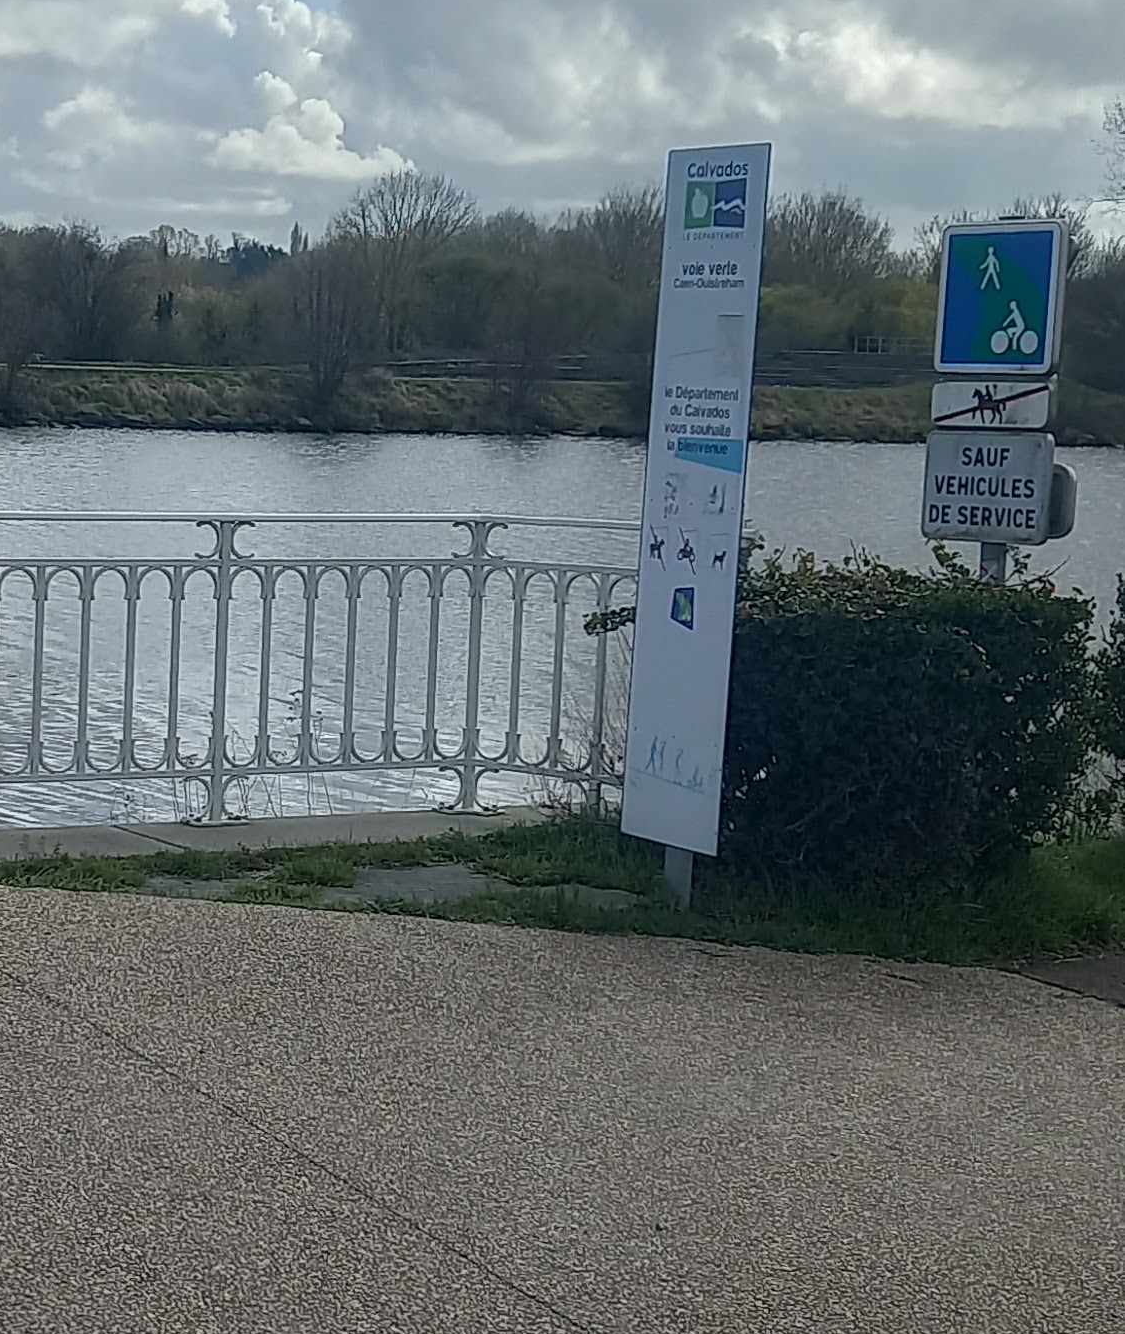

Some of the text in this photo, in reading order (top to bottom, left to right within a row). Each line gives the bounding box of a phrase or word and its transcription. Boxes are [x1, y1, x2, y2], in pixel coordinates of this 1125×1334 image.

[687, 160, 749, 178] Calvados
[682, 260, 738, 276] voie verte
[673, 277, 745, 289] Caen-Ouistreham
[664, 385, 739, 402] le Département
[670, 404, 730, 419] du Calvados
[664, 423, 732, 437] vous souhaite
[666, 439, 728, 455] la bienvenue
[961, 446, 1011, 468] SAUF
[934, 474, 1035, 499] VEHICULES
[928, 504, 1037, 529] DE SERVICE
